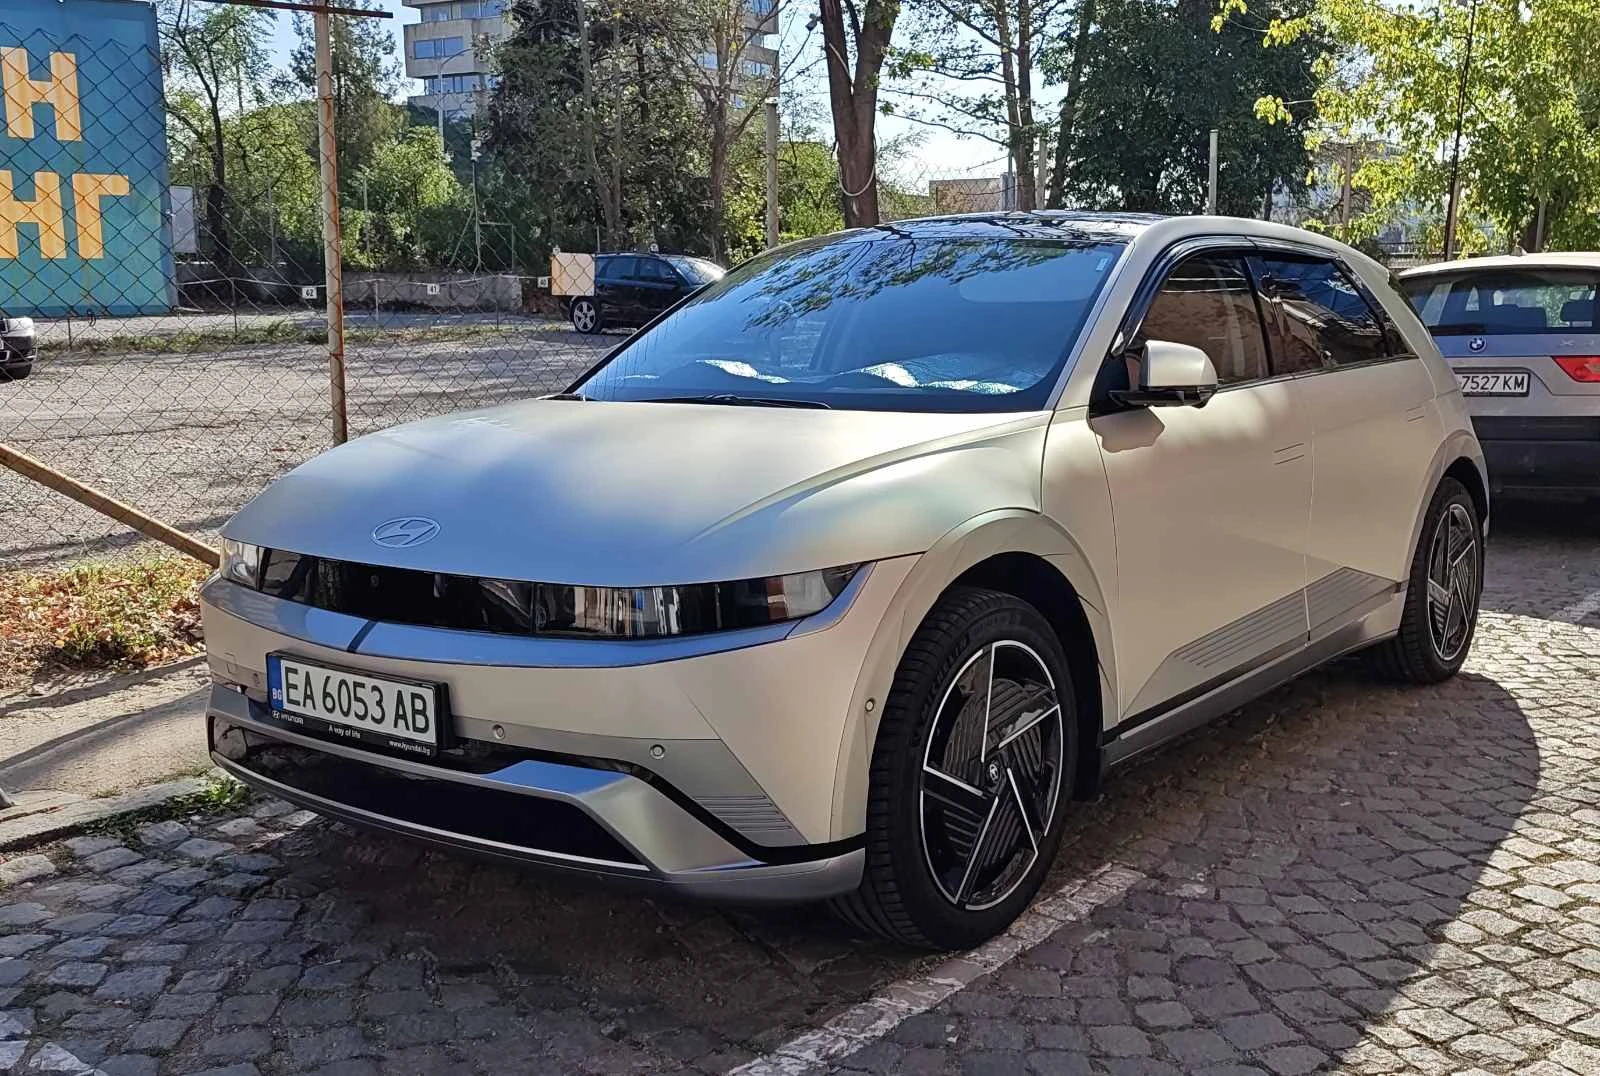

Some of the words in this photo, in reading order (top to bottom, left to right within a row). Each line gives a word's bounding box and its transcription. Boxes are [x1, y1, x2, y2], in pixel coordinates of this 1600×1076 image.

[1461, 375, 1500, 390] 7527
[1503, 375, 1525, 390] KM
[272, 687, 282, 700] BG
[393, 690, 430, 734] AB
